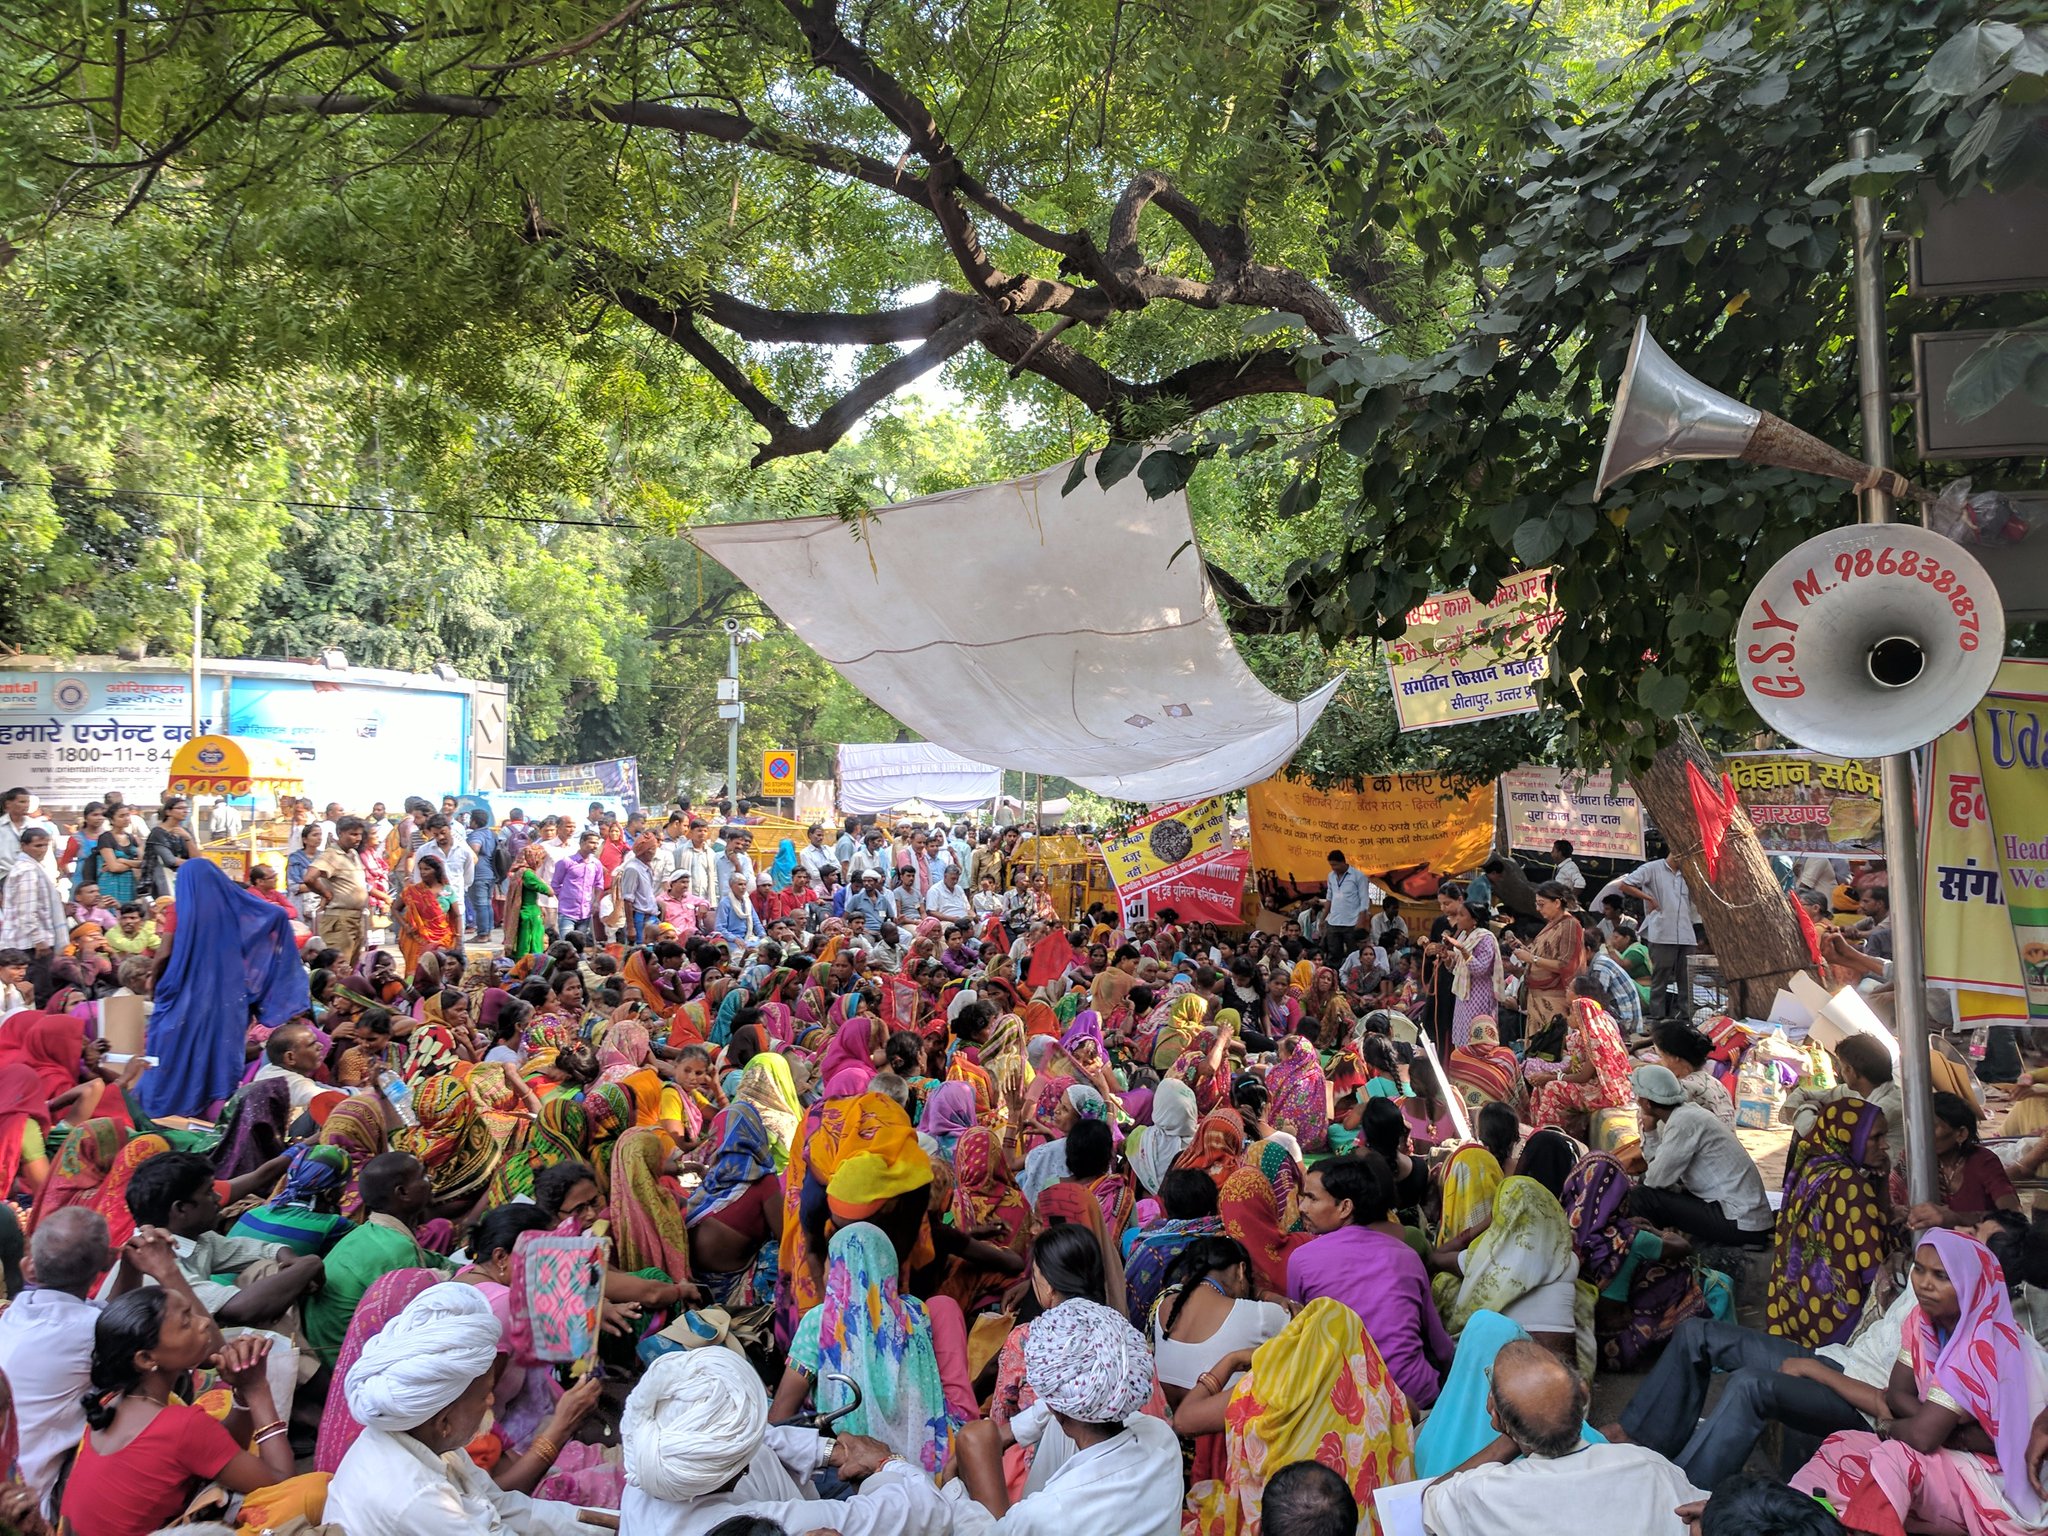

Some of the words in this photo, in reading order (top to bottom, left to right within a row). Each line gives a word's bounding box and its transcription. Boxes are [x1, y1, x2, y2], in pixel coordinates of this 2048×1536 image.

[1401, 673, 1450, 696] संगतिन
[1452, 666, 1498, 687] किसान
[1502, 656, 1544, 678] मजदूर
[0, 717, 65, 745] हमारे
[71, 717, 156, 744] एजेन्ट
[1730, 759, 1812, 793] विज्ञान
[1511, 791, 1539, 803] हमारा
[1540, 790, 1560, 804] पैसा
[1547, 811, 1570, 822] काम
[1580, 813, 1597, 825] पुरा
[1600, 814, 1621, 826] दाम
[1748, 804, 1832, 826] झारखण्ड
[1207, 862, 1241, 882] INITIATIVE
